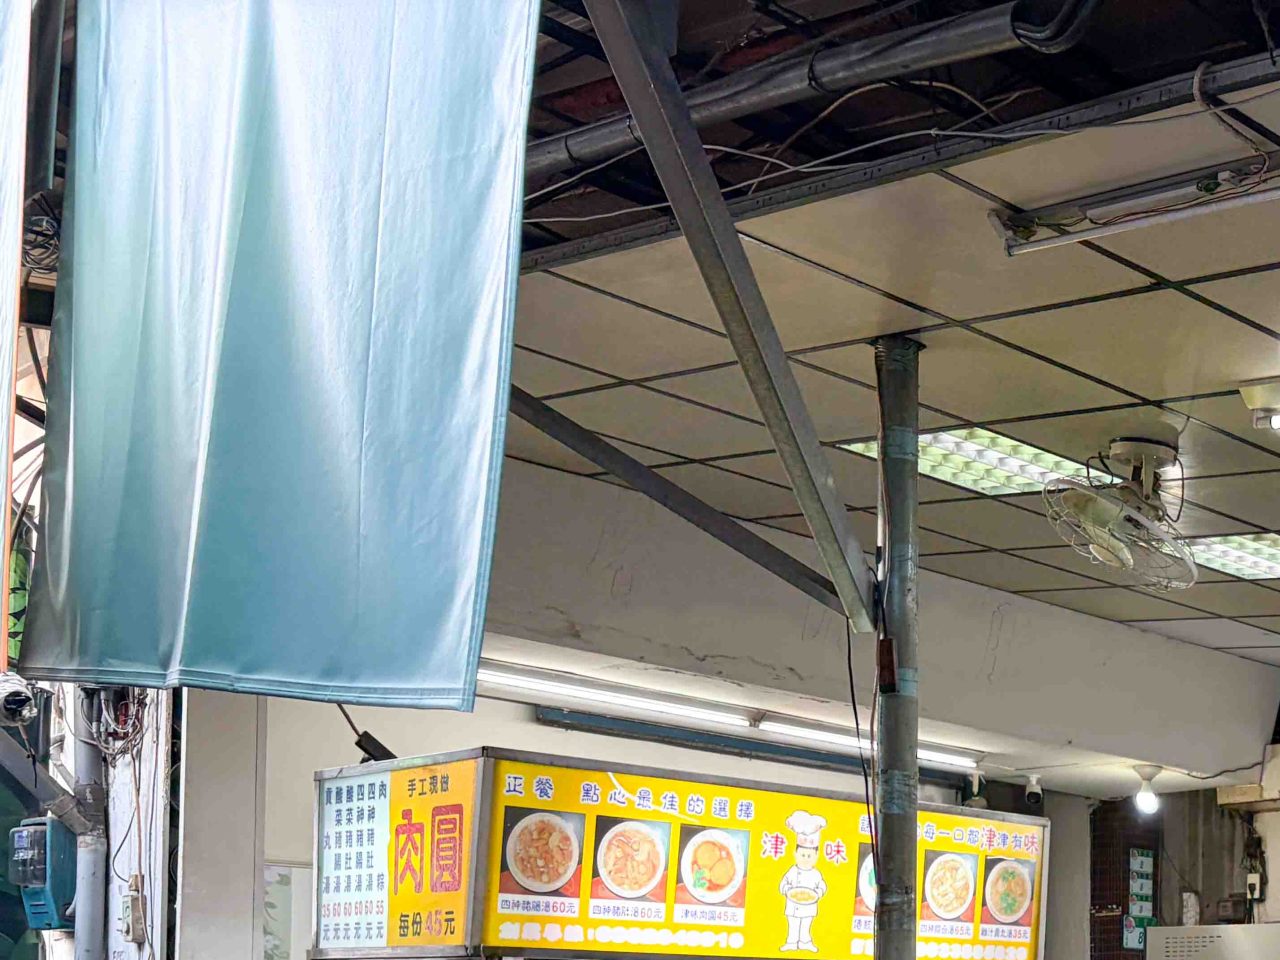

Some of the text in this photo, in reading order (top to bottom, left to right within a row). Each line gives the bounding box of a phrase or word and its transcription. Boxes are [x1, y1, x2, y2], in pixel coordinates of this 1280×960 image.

[407, 774, 450, 798] 手工現做
[505, 775, 554, 800] 正餐
[394, 804, 464, 896] 肉圓
[762, 832, 847, 864] 津 味
[398, 911, 456, 938] 每份45元
